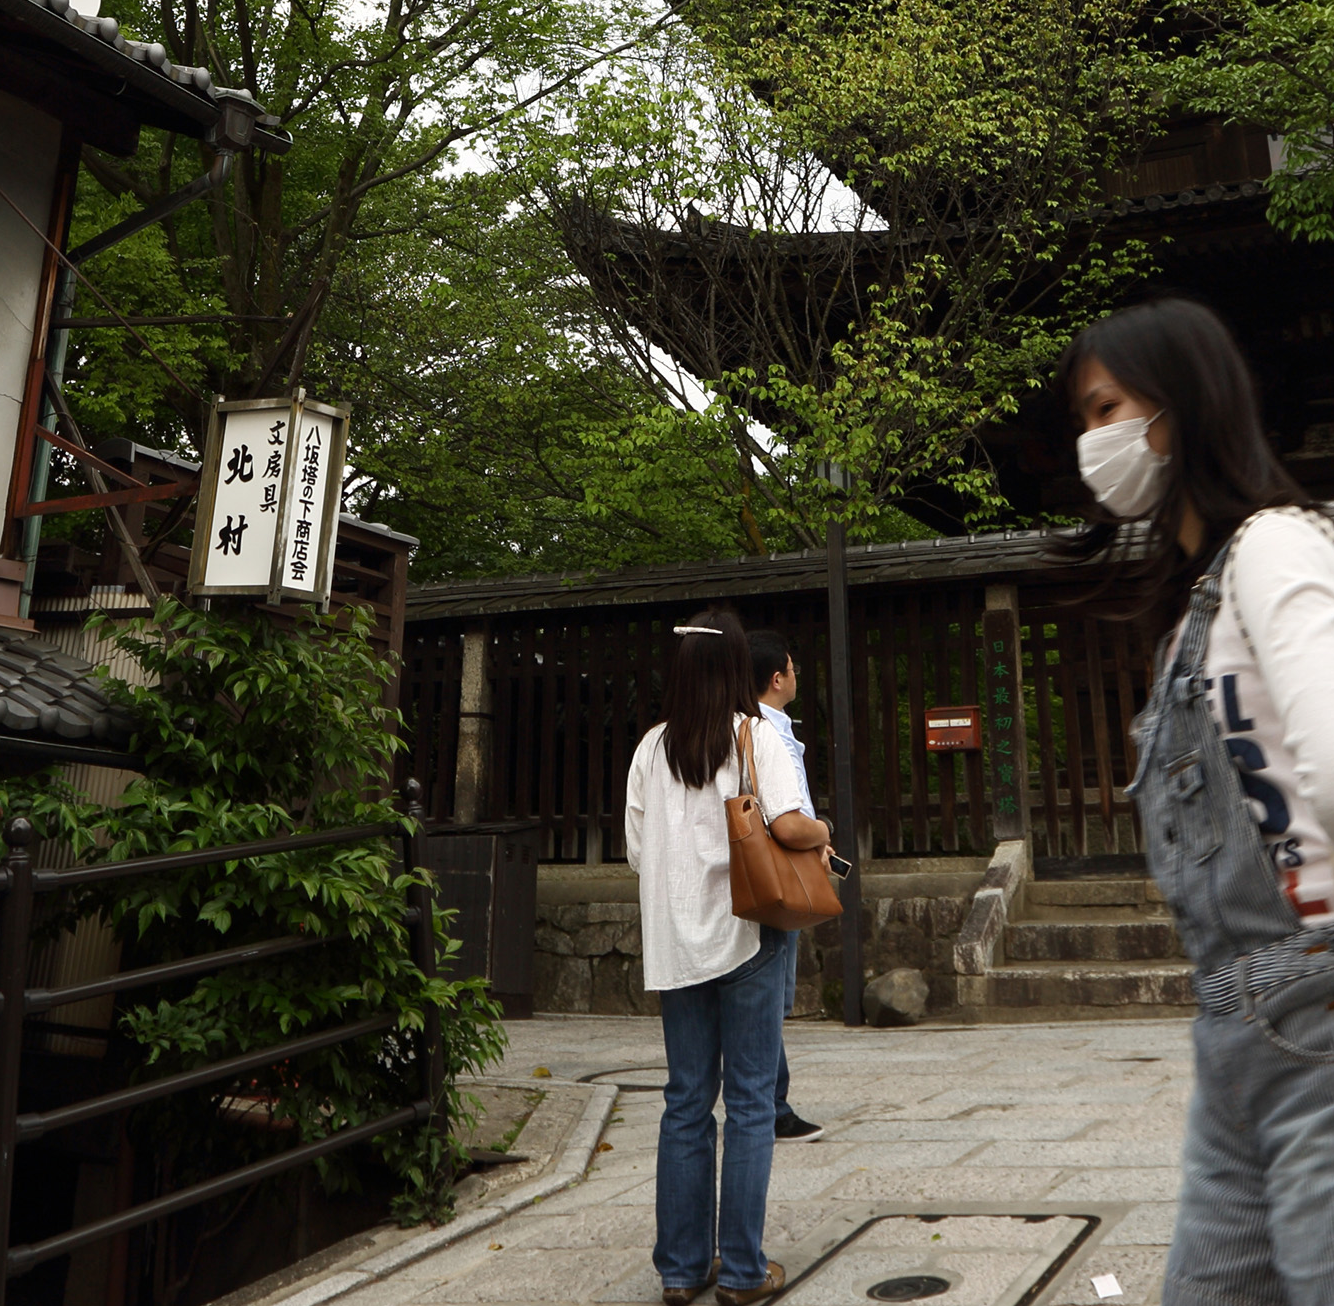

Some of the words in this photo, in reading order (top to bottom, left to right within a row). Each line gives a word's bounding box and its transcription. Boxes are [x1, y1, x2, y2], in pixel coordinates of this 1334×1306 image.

[215, 444, 254, 556] 北村
[259, 420, 286, 513] 文房具
[290, 425, 321, 582] 八坂塔の下商店会
[1204, 673, 1255, 732] L
